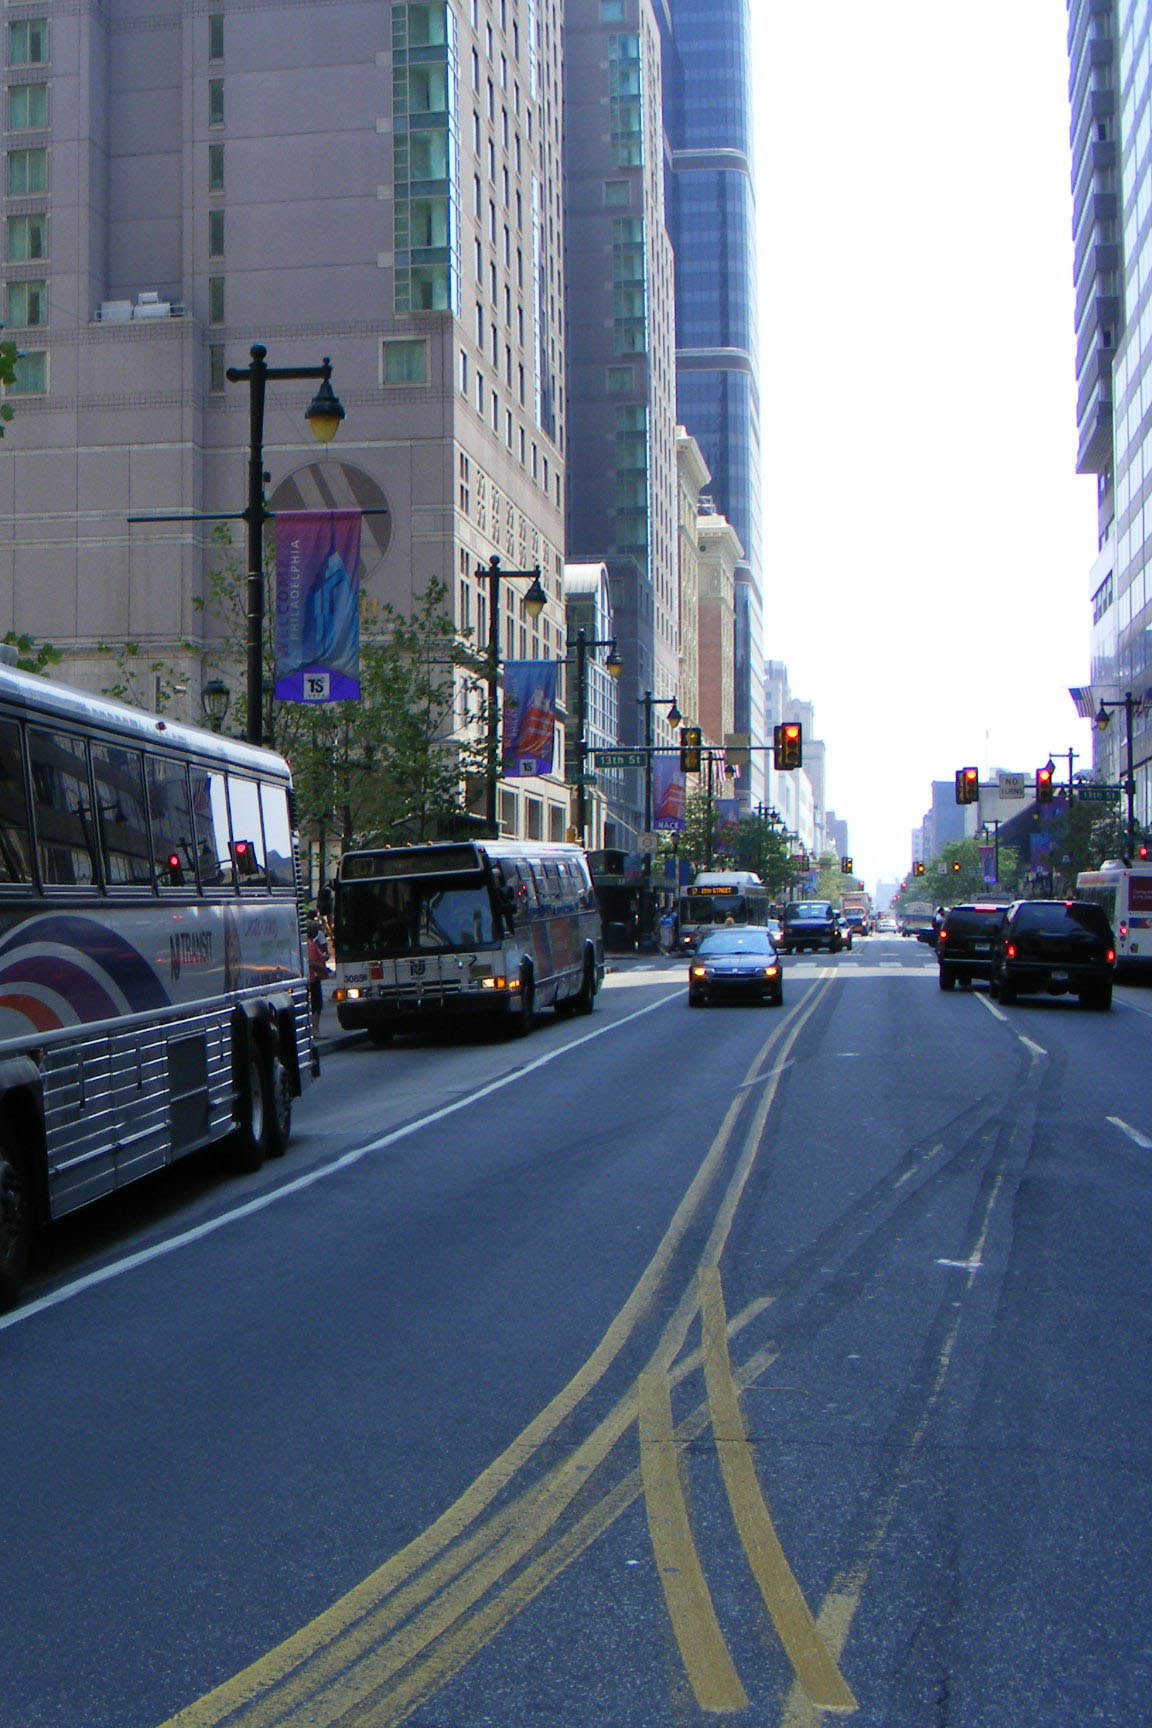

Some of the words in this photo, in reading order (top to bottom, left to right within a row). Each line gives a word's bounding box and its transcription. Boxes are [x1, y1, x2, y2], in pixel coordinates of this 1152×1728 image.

[290, 540, 300, 641] PHILADELPHIA
[600, 755, 625, 765] 13th
[629, 755, 641, 764] St
[1005, 778, 1018, 786] NO
[169, 933, 181, 981] NJ
[180, 930, 213, 965] TRANSIT
